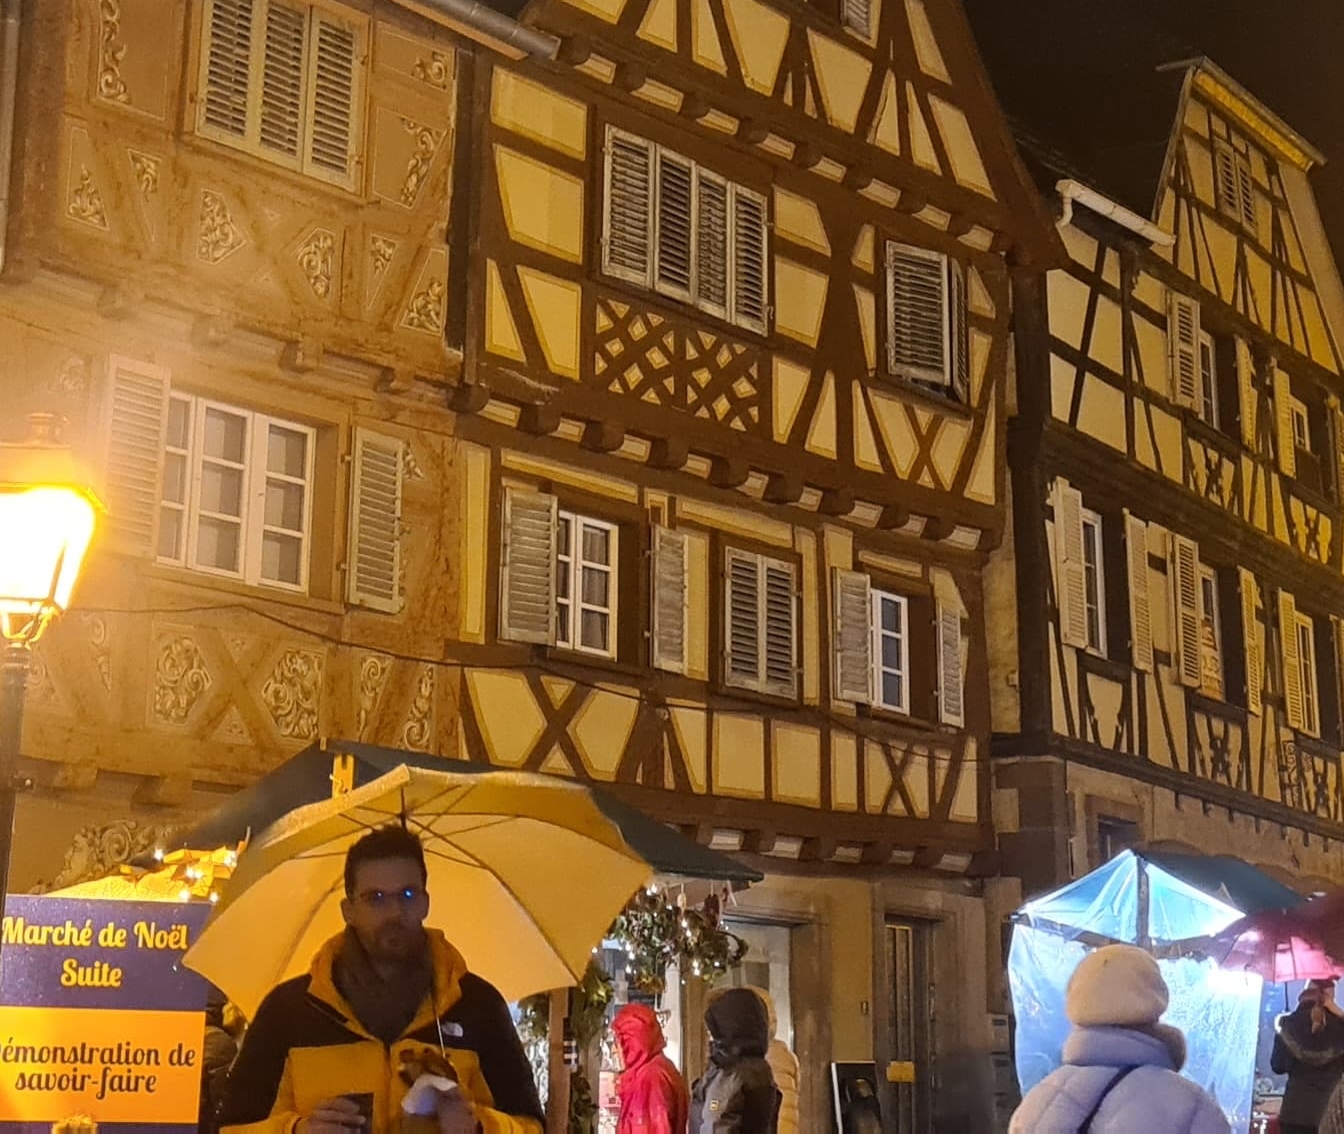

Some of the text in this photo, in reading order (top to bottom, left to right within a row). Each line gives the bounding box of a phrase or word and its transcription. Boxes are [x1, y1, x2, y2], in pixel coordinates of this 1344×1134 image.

[1, 916, 189, 950] Marché de Noël
[60, 958, 123, 987] Suite
[168, 1043, 196, 1067] de
[15, 1067, 157, 1100] savoir-faire
